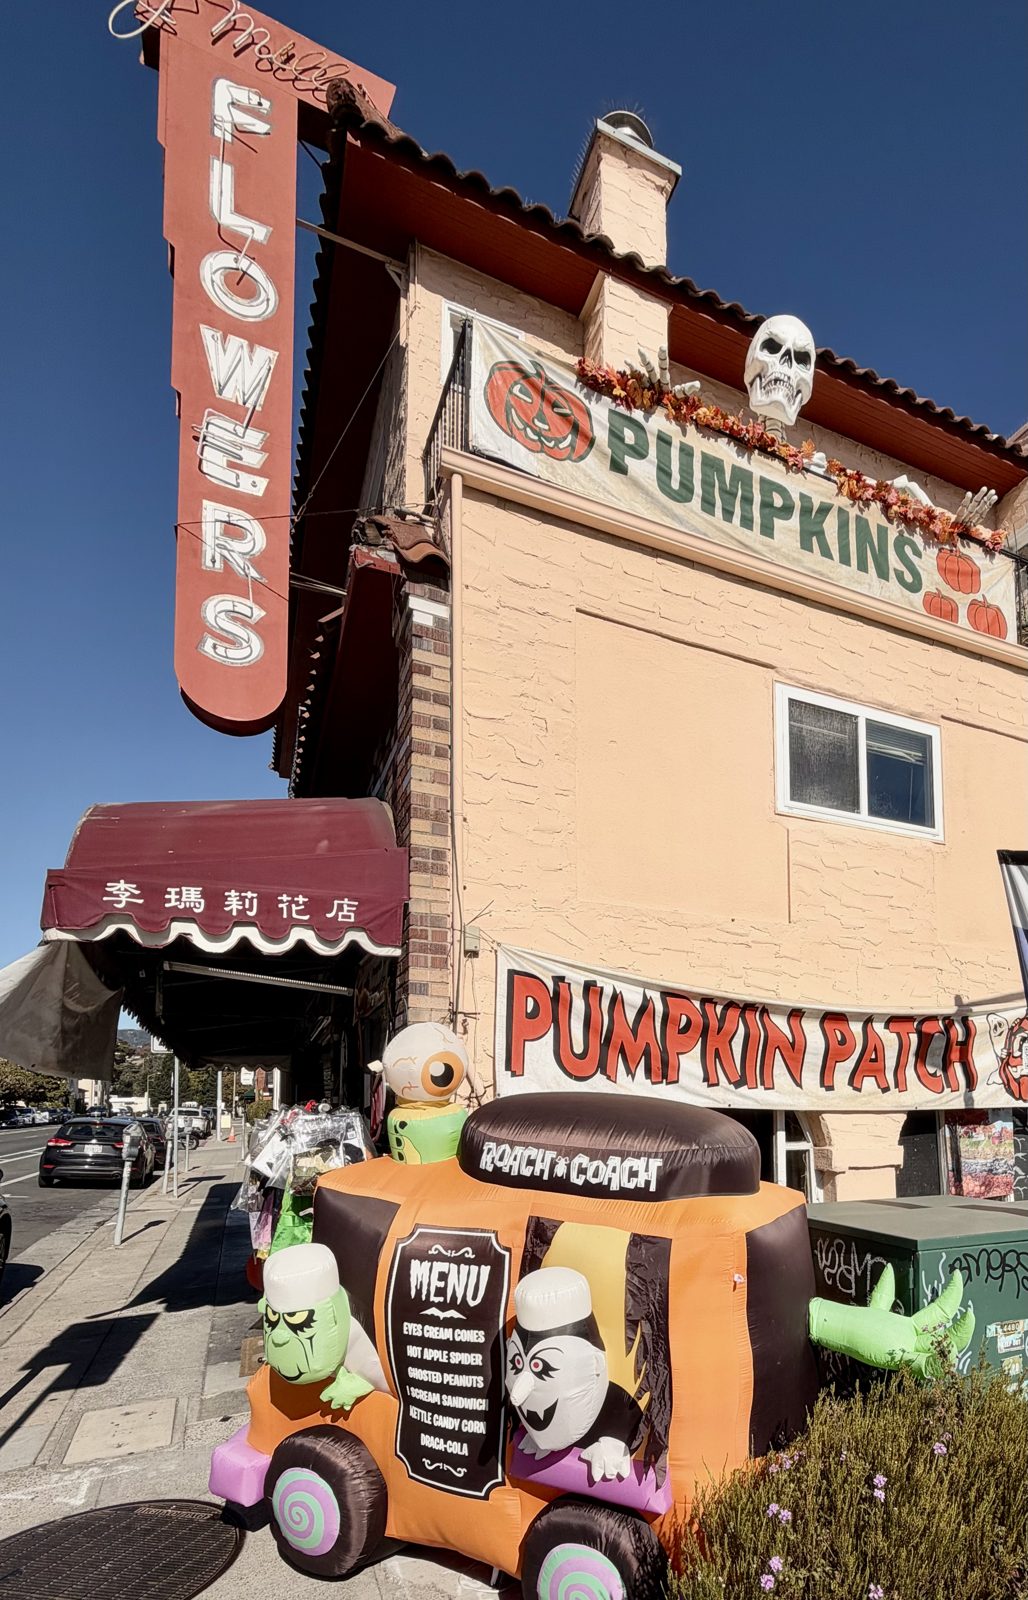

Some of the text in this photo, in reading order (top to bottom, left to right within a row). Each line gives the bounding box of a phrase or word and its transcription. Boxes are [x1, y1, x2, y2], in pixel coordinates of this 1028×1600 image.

[194, 77, 279, 667] FLOWERS
[607, 409, 924, 594] PUMPKINS
[102, 879, 359, 922] 李瑪莉花店
[505, 968, 979, 1093] PUMPKIN PATCH
[480, 1141, 663, 1192] ROACH COACH
[409, 1259, 491, 1307] MENU
[403, 1321, 485, 1343] EYES CREAM CONES
[406, 1345, 483, 1366] HOT APPLE SPIDER
[407, 1366, 484, 1388] GHOSTED PEANUTS
[410, 1386, 440, 1405] SCREAM
[442, 1394, 489, 1411] SANDWICH
[409, 1404, 487, 1434] KETTLE CANDY CORN
[420, 1432, 469, 1456] DRACA-COLA
